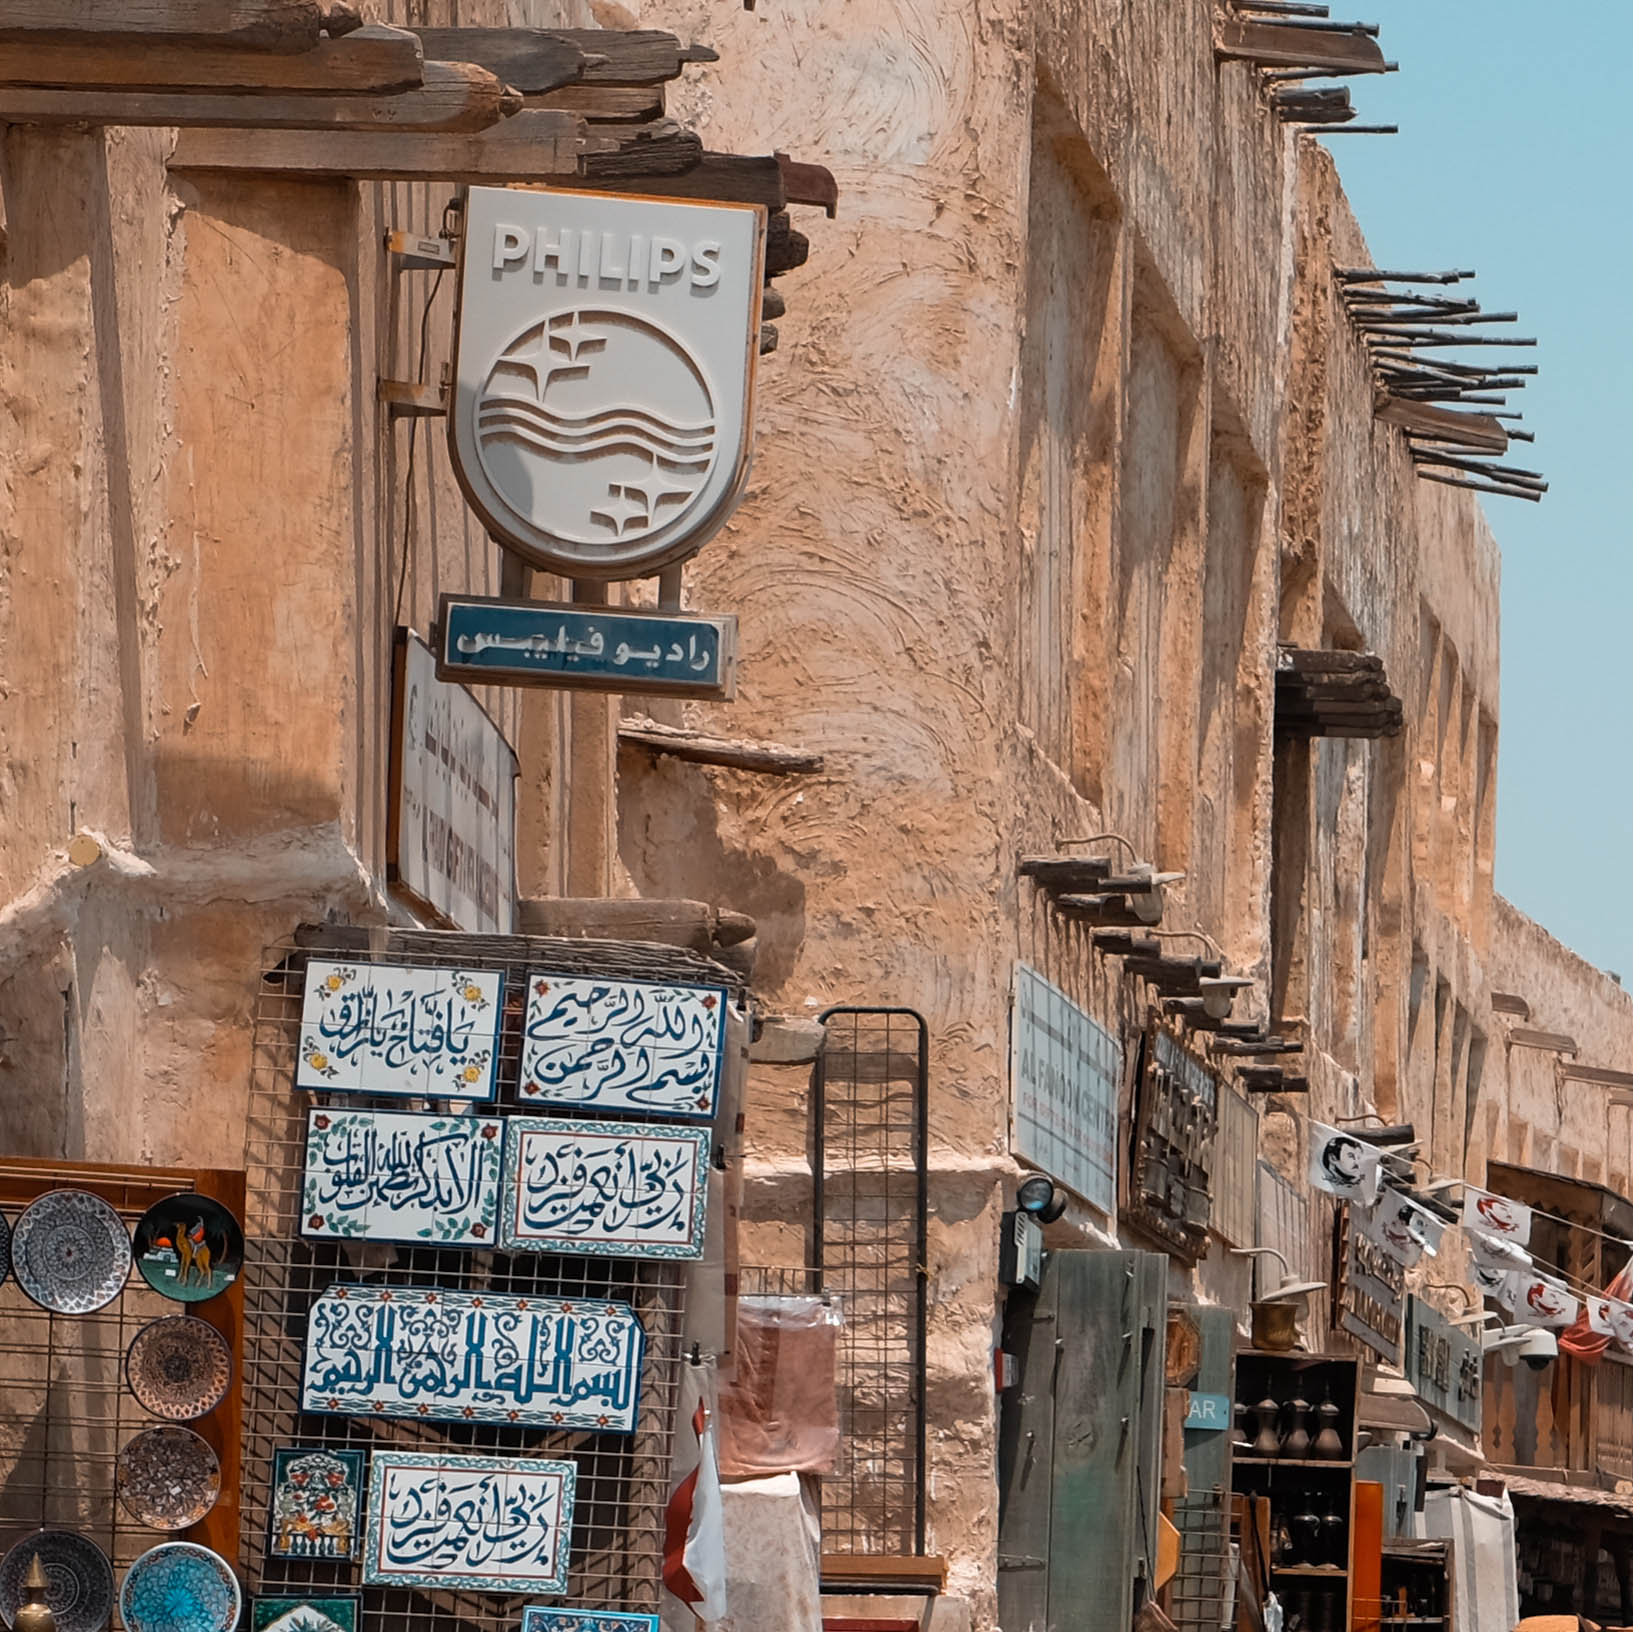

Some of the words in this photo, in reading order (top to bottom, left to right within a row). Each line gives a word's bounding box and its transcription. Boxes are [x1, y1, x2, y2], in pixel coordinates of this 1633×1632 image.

[492, 223, 722, 288] PHILIPS
[456, 625, 604, 662] فيليبس
[613, 634, 710, 671] راديو
[306, 1303, 397, 1395] الرحيم
[398, 1309, 491, 1399] الرحمن
[494, 1312, 573, 1404] الله
[549, 1321, 639, 1410] بسم
[1188, 1400, 1216, 1419] AR
